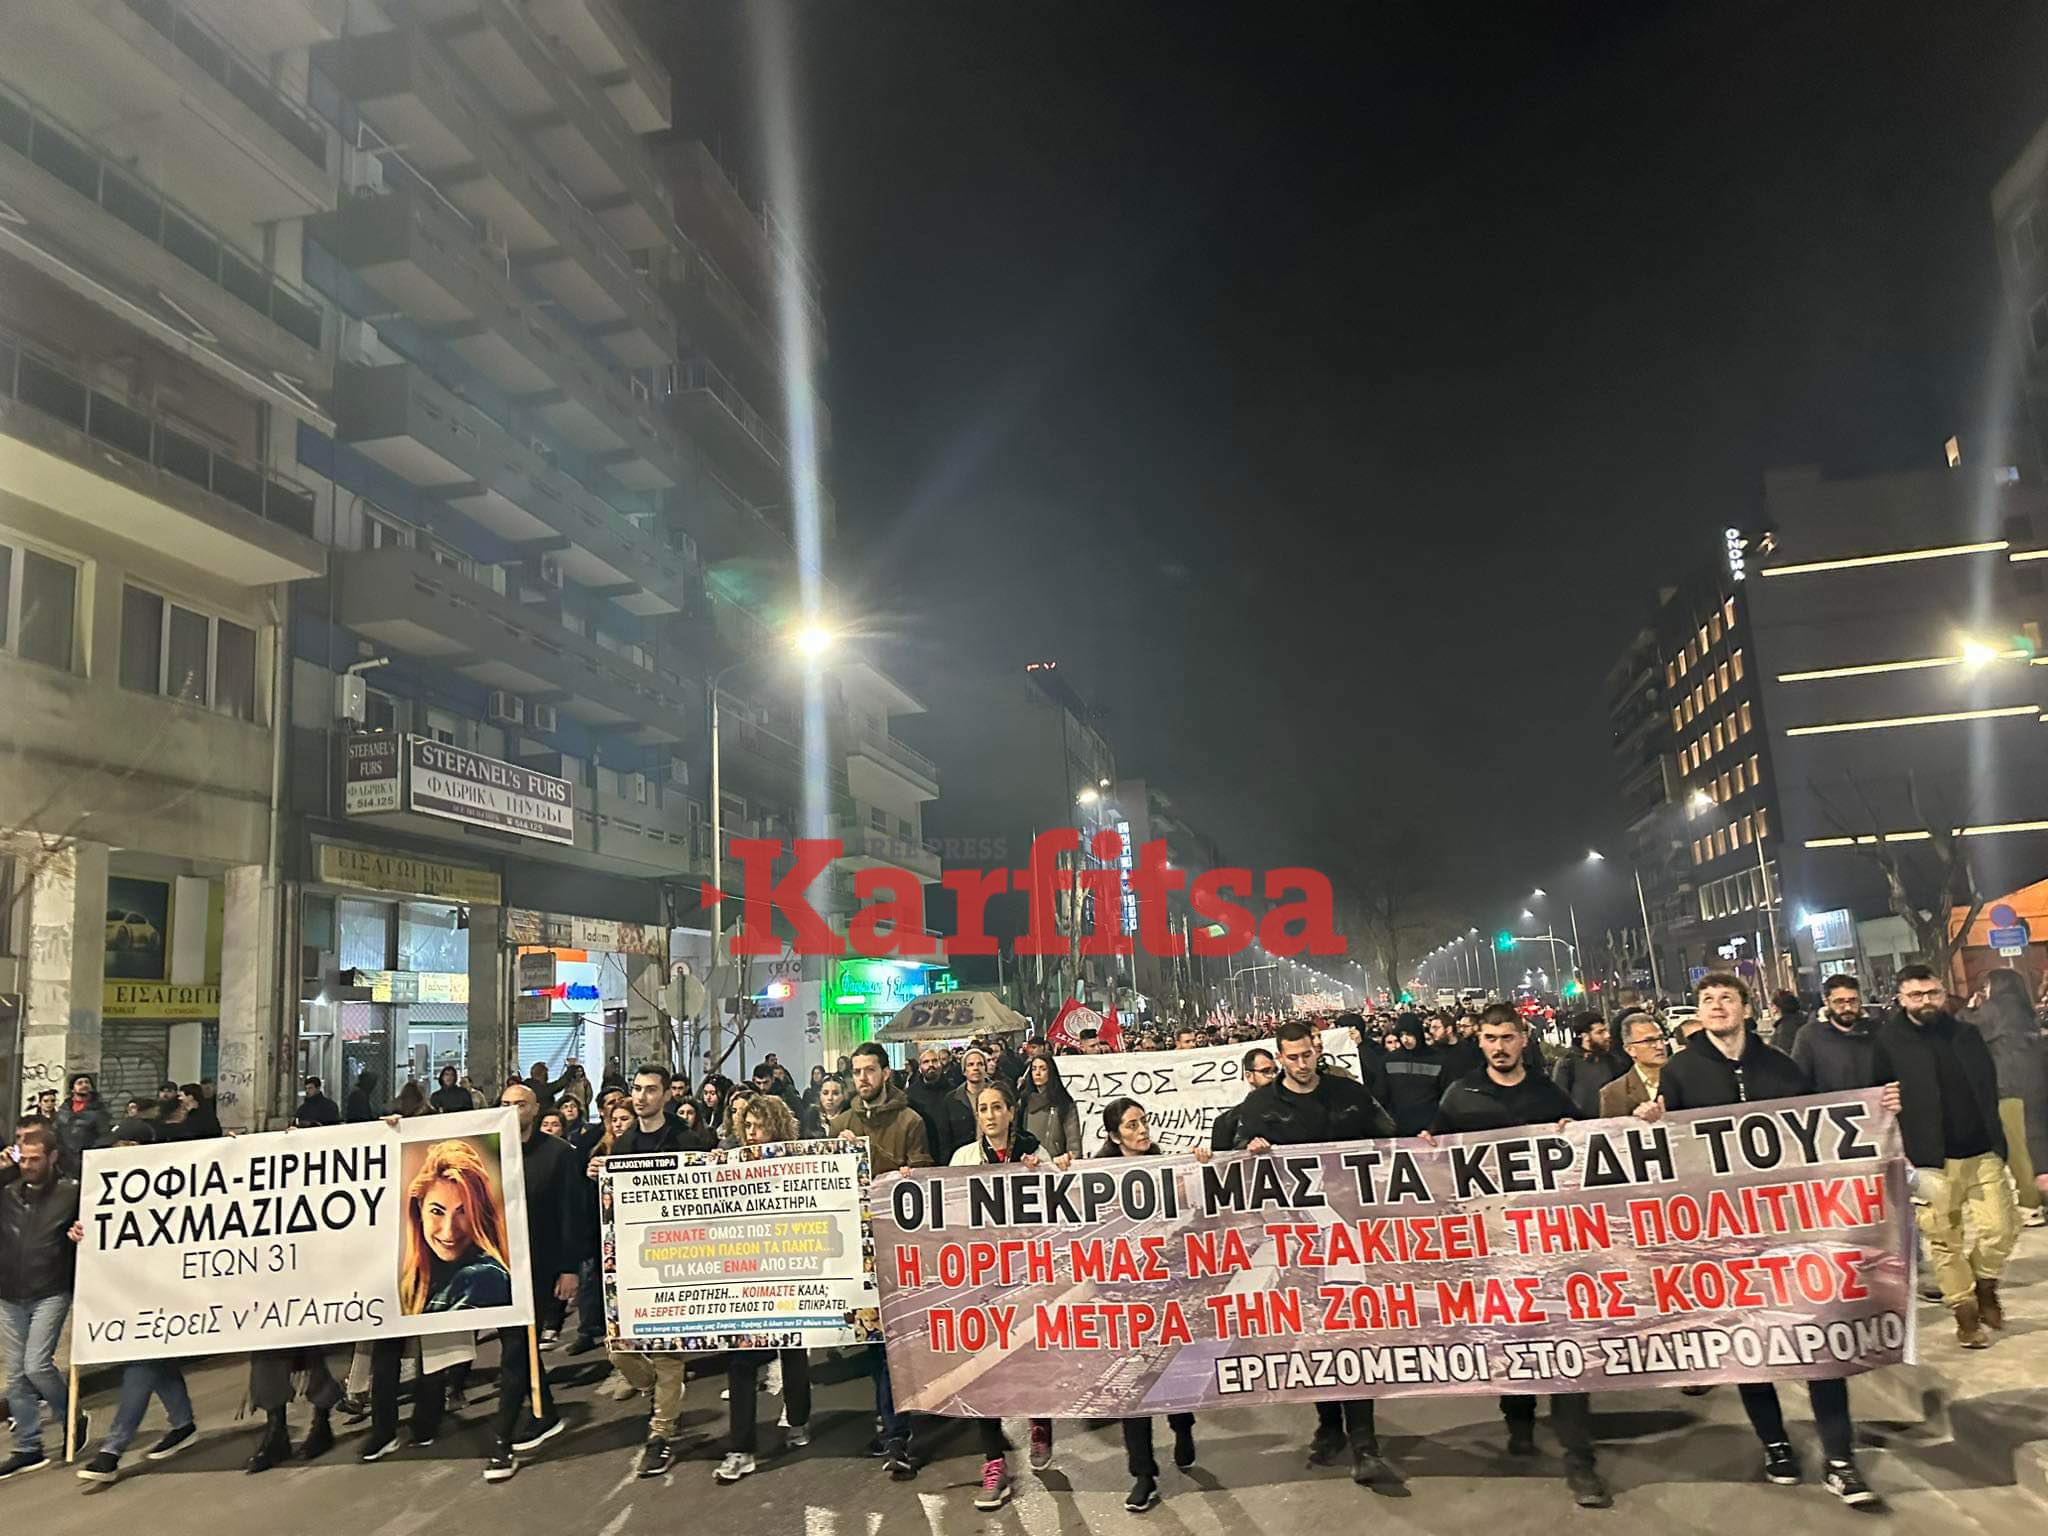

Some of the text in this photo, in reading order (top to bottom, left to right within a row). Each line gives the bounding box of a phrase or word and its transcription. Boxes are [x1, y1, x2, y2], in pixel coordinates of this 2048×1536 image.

[360, 760, 383, 777] FURS
[427, 776, 495, 807] ФАБРИКА
[527, 775, 566, 801] FURS
[357, 796, 394, 809] 514.125
[97, 1145, 387, 1206] ΣΟΦΙΑ-ΕΙΡΗΝΗ
[632, 1162, 839, 1187] ΦΑΙΝΕΤΑΙ ΟΤΙ ΔΕΝ ΑΝΗΣΥΧΕΙΤΕ ΓΙΑ
[655, 1158, 676, 1167] ΤΩΡΑ
[892, 1101, 1881, 1232] ΟΙ ΝΕΚΡΟΙ ΜΑΣ ΤΑ ΚΕΡΔΗ ΤΟΥΣ
[621, 1185, 699, 1204] ΕΞΕΤΑΣΤΙΚΕΣ
[702, 1183, 771, 1200] ΕΠΙΤΡΟΠΕΣ
[783, 1178, 851, 1192] ΕΙΣΑΓΓΕΛΙΕΣ
[94, 1187, 386, 1250] ΤΑΧΜΑΖΙΔΟΥ
[661, 1195, 818, 1218] & ΕΥΡΩΠΑΪΚΑ ΔΙΚΑΣΤΗΡΙΑ
[650, 1221, 829, 1244] ΞΕΧΝΑΤΕ ΟΜΩΣ ΠΩΣ 57 ΨΥΧΕΣ
[894, 1173, 1886, 1289] Η ΟΡΓΗ ΜΑΣ ΝΑ ΤΣΑΚΙΣΕΙ ΤΗΝ ΠΟΛΙΤΙΚΗ
[182, 1243, 298, 1280] ΕΤΩΝ 31
[644, 1244, 717, 1261] ΓΝΩΡΙΖΟΥΝ
[719, 1242, 760, 1257] ΠΛΕΟΝ
[763, 1241, 780, 1254] ΤΑ
[664, 1256, 818, 1278] ΓΙΑ ΚΑΘΕ ΕΝΑΝ ΑΠΟ ΕΣΑΣ
[655, 1283, 829, 1303] ΜΙΑ ΕΡΩΤΗΣΗ... ΚΟΙΜΑΣΤΕ ΚΑΛΑ;
[927, 1249, 1870, 1354] ΠΟΥ ΜΕΤΡΑ ΤΗΝ ΖΩΗ ΜΑΣ ΩΣ ΚΟΣΤΟΣ
[634, 1307, 648, 1319] ΝΑ
[650, 1304, 686, 1317] ΞΕΡΕΤΕ
[688, 1303, 705, 1315] ΟΤΙ
[707, 1302, 726, 1314] ΣΤΟ
[729, 1300, 759, 1313] ΤΕΛΟΣ
[761, 1301, 774, 1312] ΤΟ
[88, 1318, 126, 1343] να
[133, 1305, 223, 1346] ΞέρειΣ
[1215, 1311, 1905, 1395] ΕΡΓΑΖΟΜΕΝΟΙ ΣΤΟ ΣΙΔΗΡΟΔΡΟΜΟ
